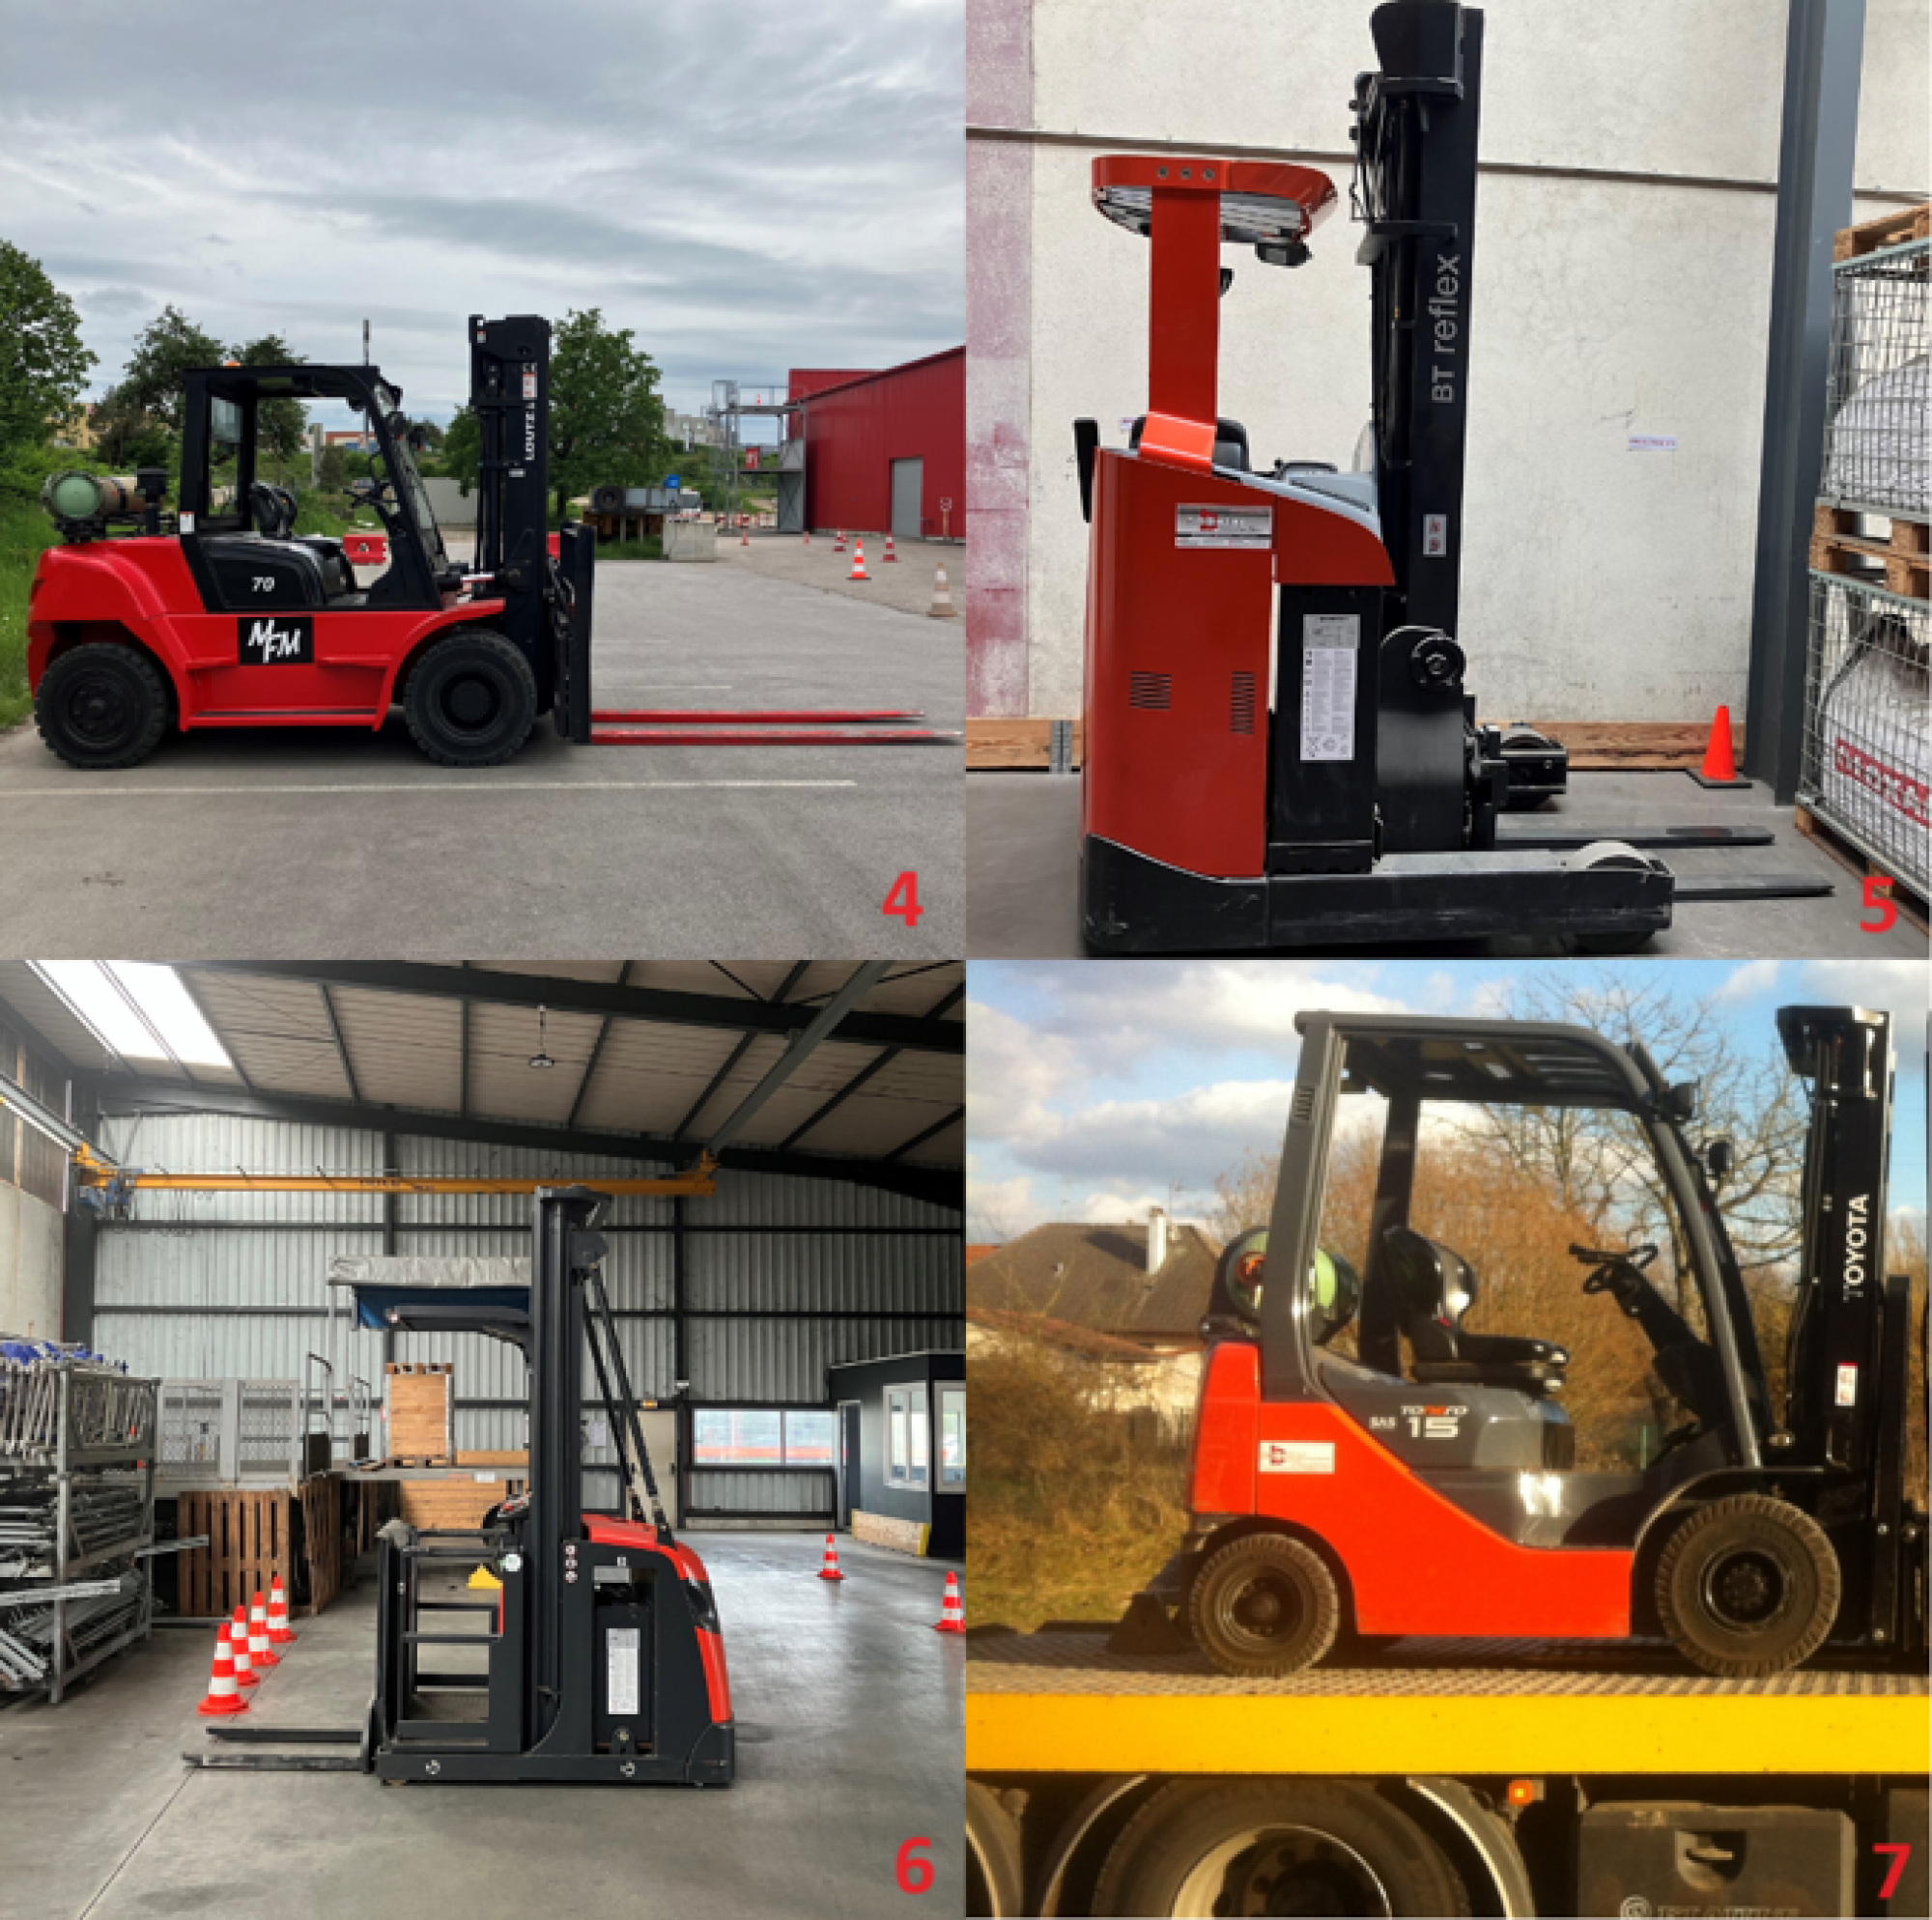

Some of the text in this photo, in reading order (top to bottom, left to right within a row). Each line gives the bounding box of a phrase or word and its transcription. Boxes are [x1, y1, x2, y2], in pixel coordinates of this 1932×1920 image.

[1428, 254, 1461, 403] BT reflex
[251, 577, 275, 592] 70
[1843, 1194, 1869, 1303] TOYOTA
[1406, 1417, 1459, 1440] 15
